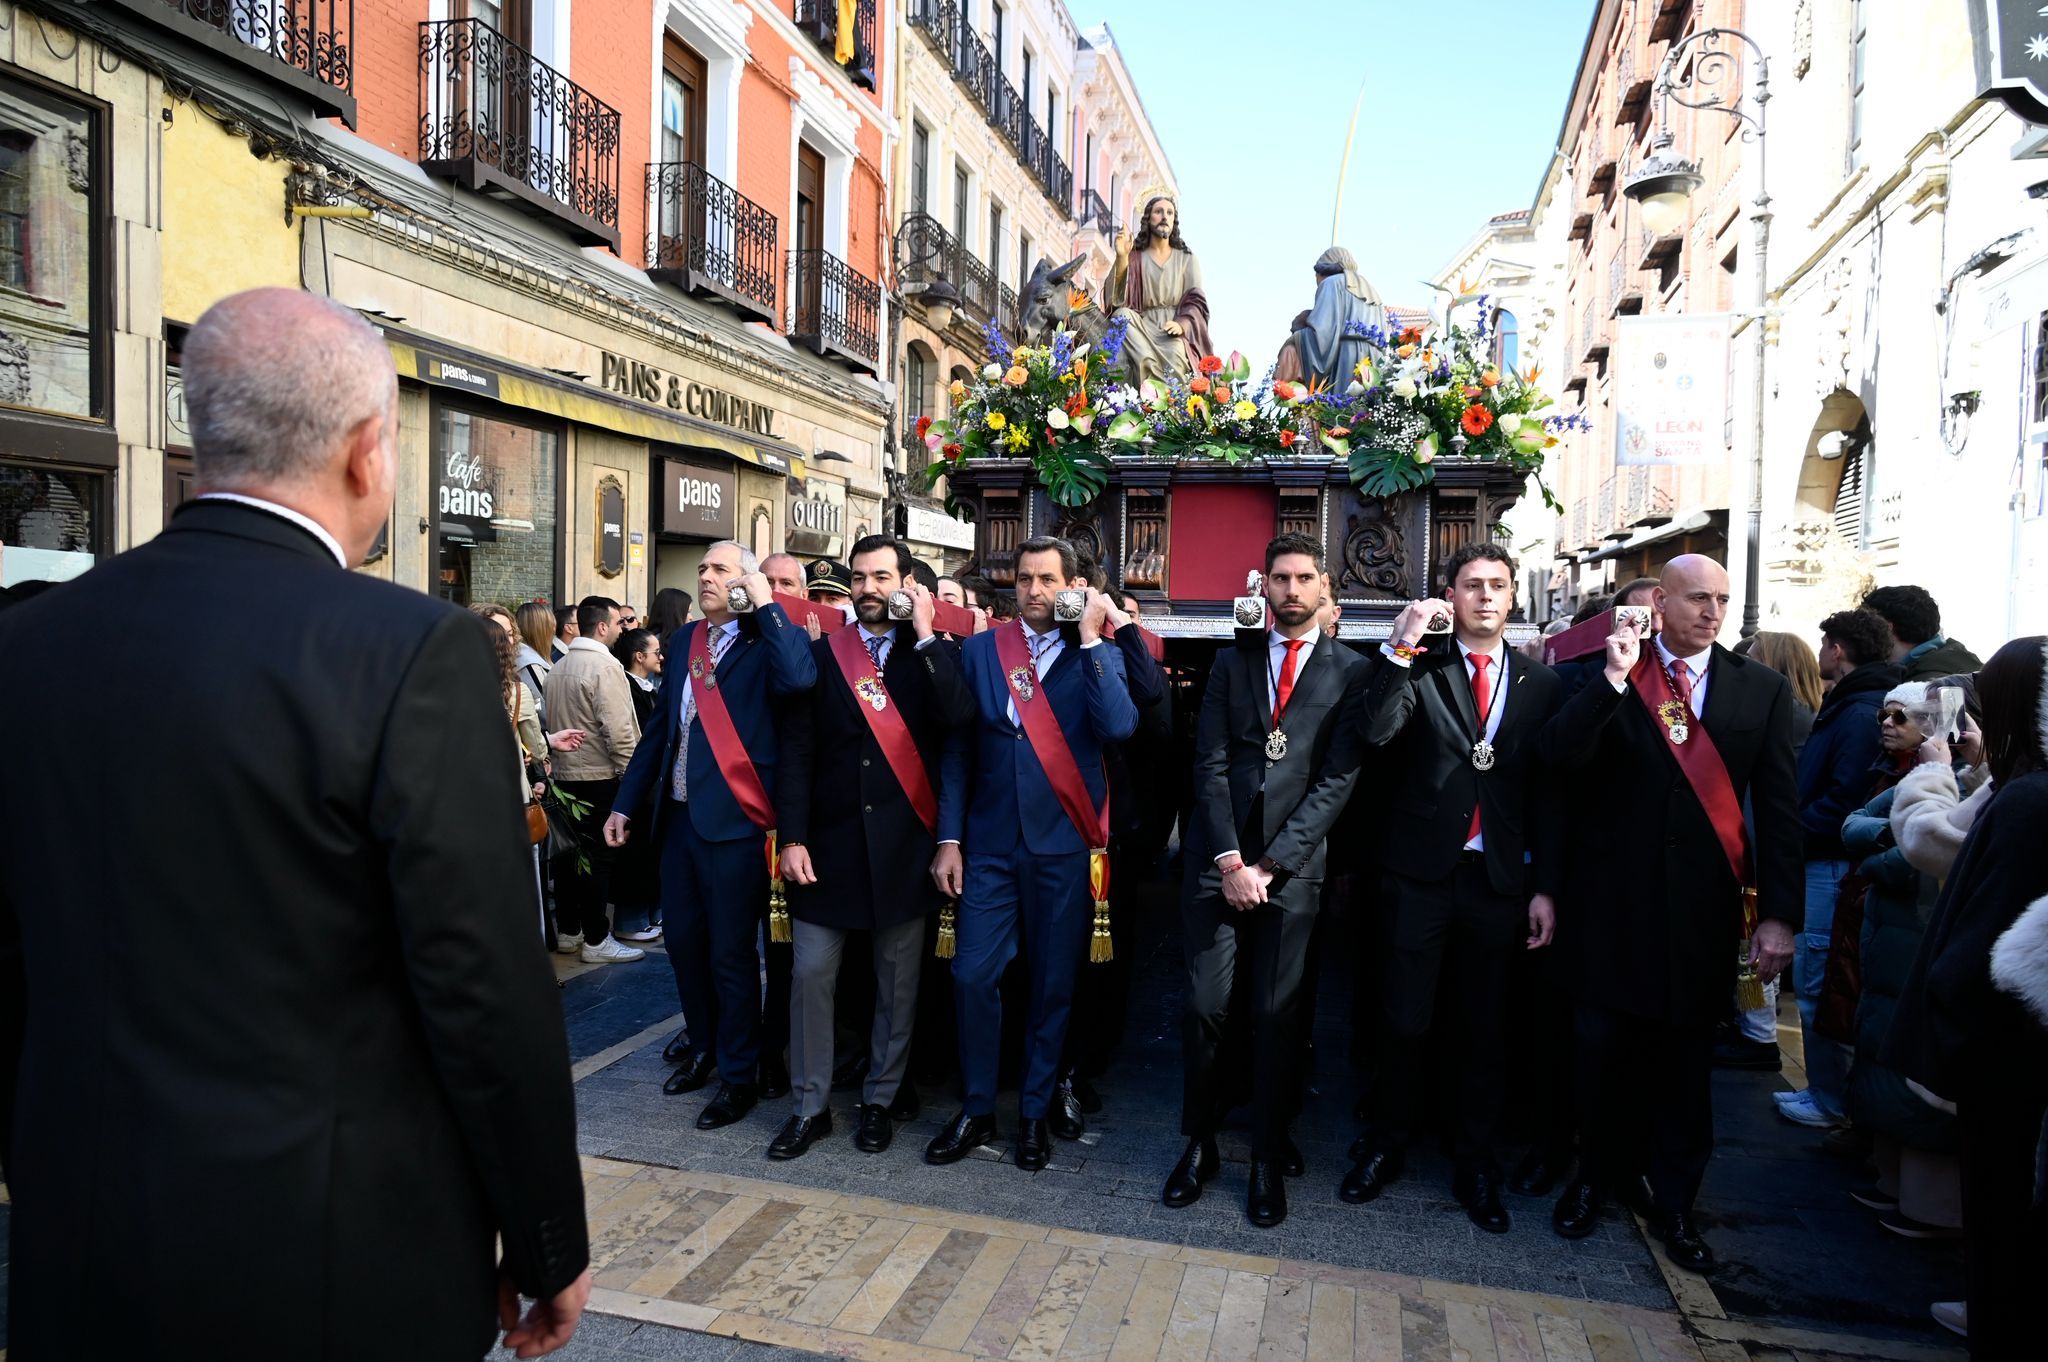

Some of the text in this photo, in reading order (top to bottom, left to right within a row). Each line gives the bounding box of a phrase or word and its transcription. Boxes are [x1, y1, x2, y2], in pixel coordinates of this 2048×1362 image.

[441, 362, 469, 382] pans
[601, 351, 775, 435] PANS & COMPANY
[1655, 447, 1702, 458] SANTA
[679, 477, 721, 513] pans
[604, 522, 621, 535] pans
[793, 500, 842, 533] Outfit
